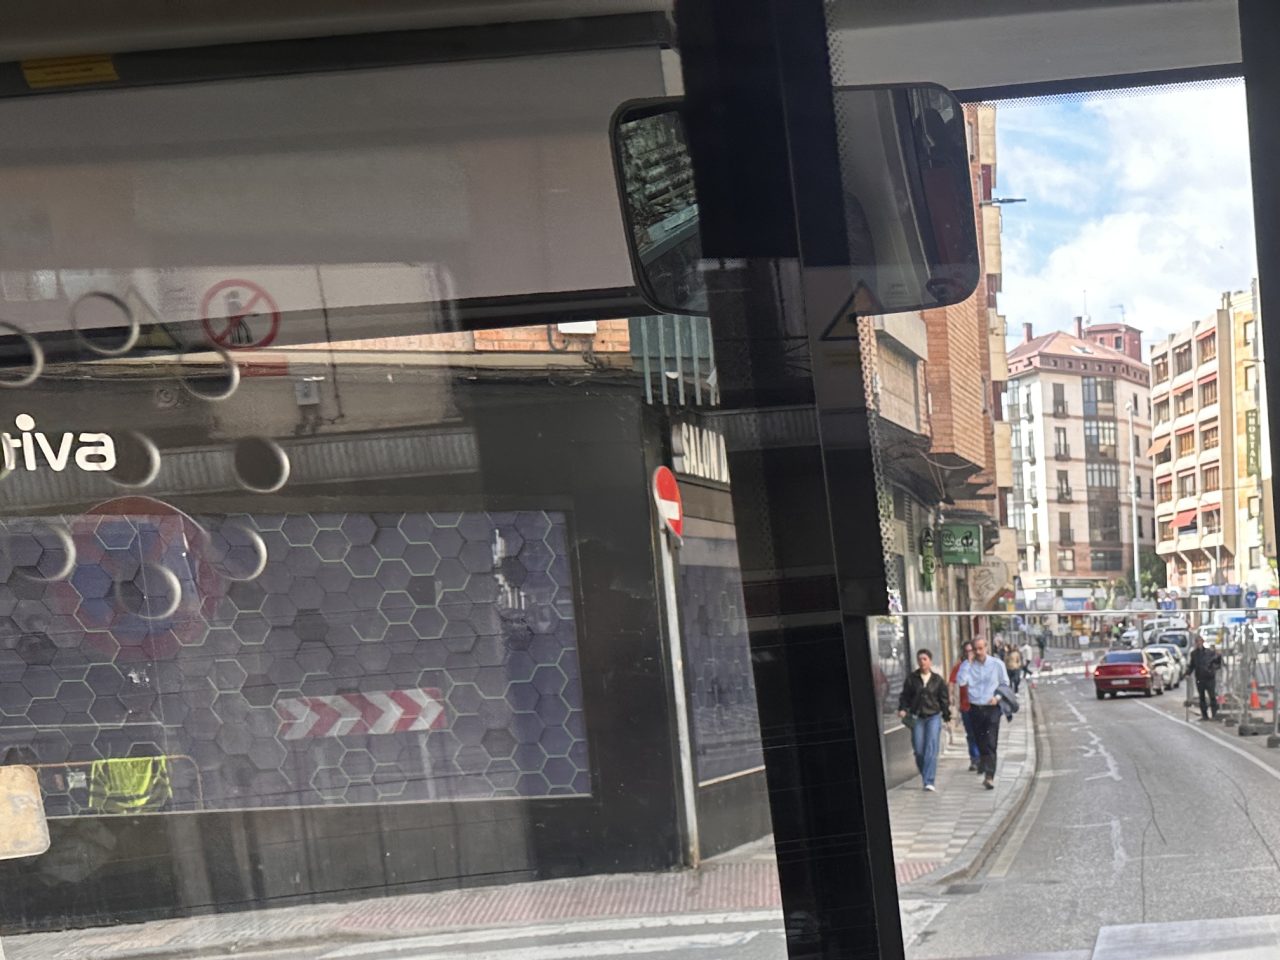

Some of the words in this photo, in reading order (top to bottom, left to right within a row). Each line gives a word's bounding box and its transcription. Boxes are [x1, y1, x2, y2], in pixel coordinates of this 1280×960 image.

[681, 422, 720, 481] SALON
[720, 433, 731, 484] D
[1247, 417, 1257, 465] HOSTAL
